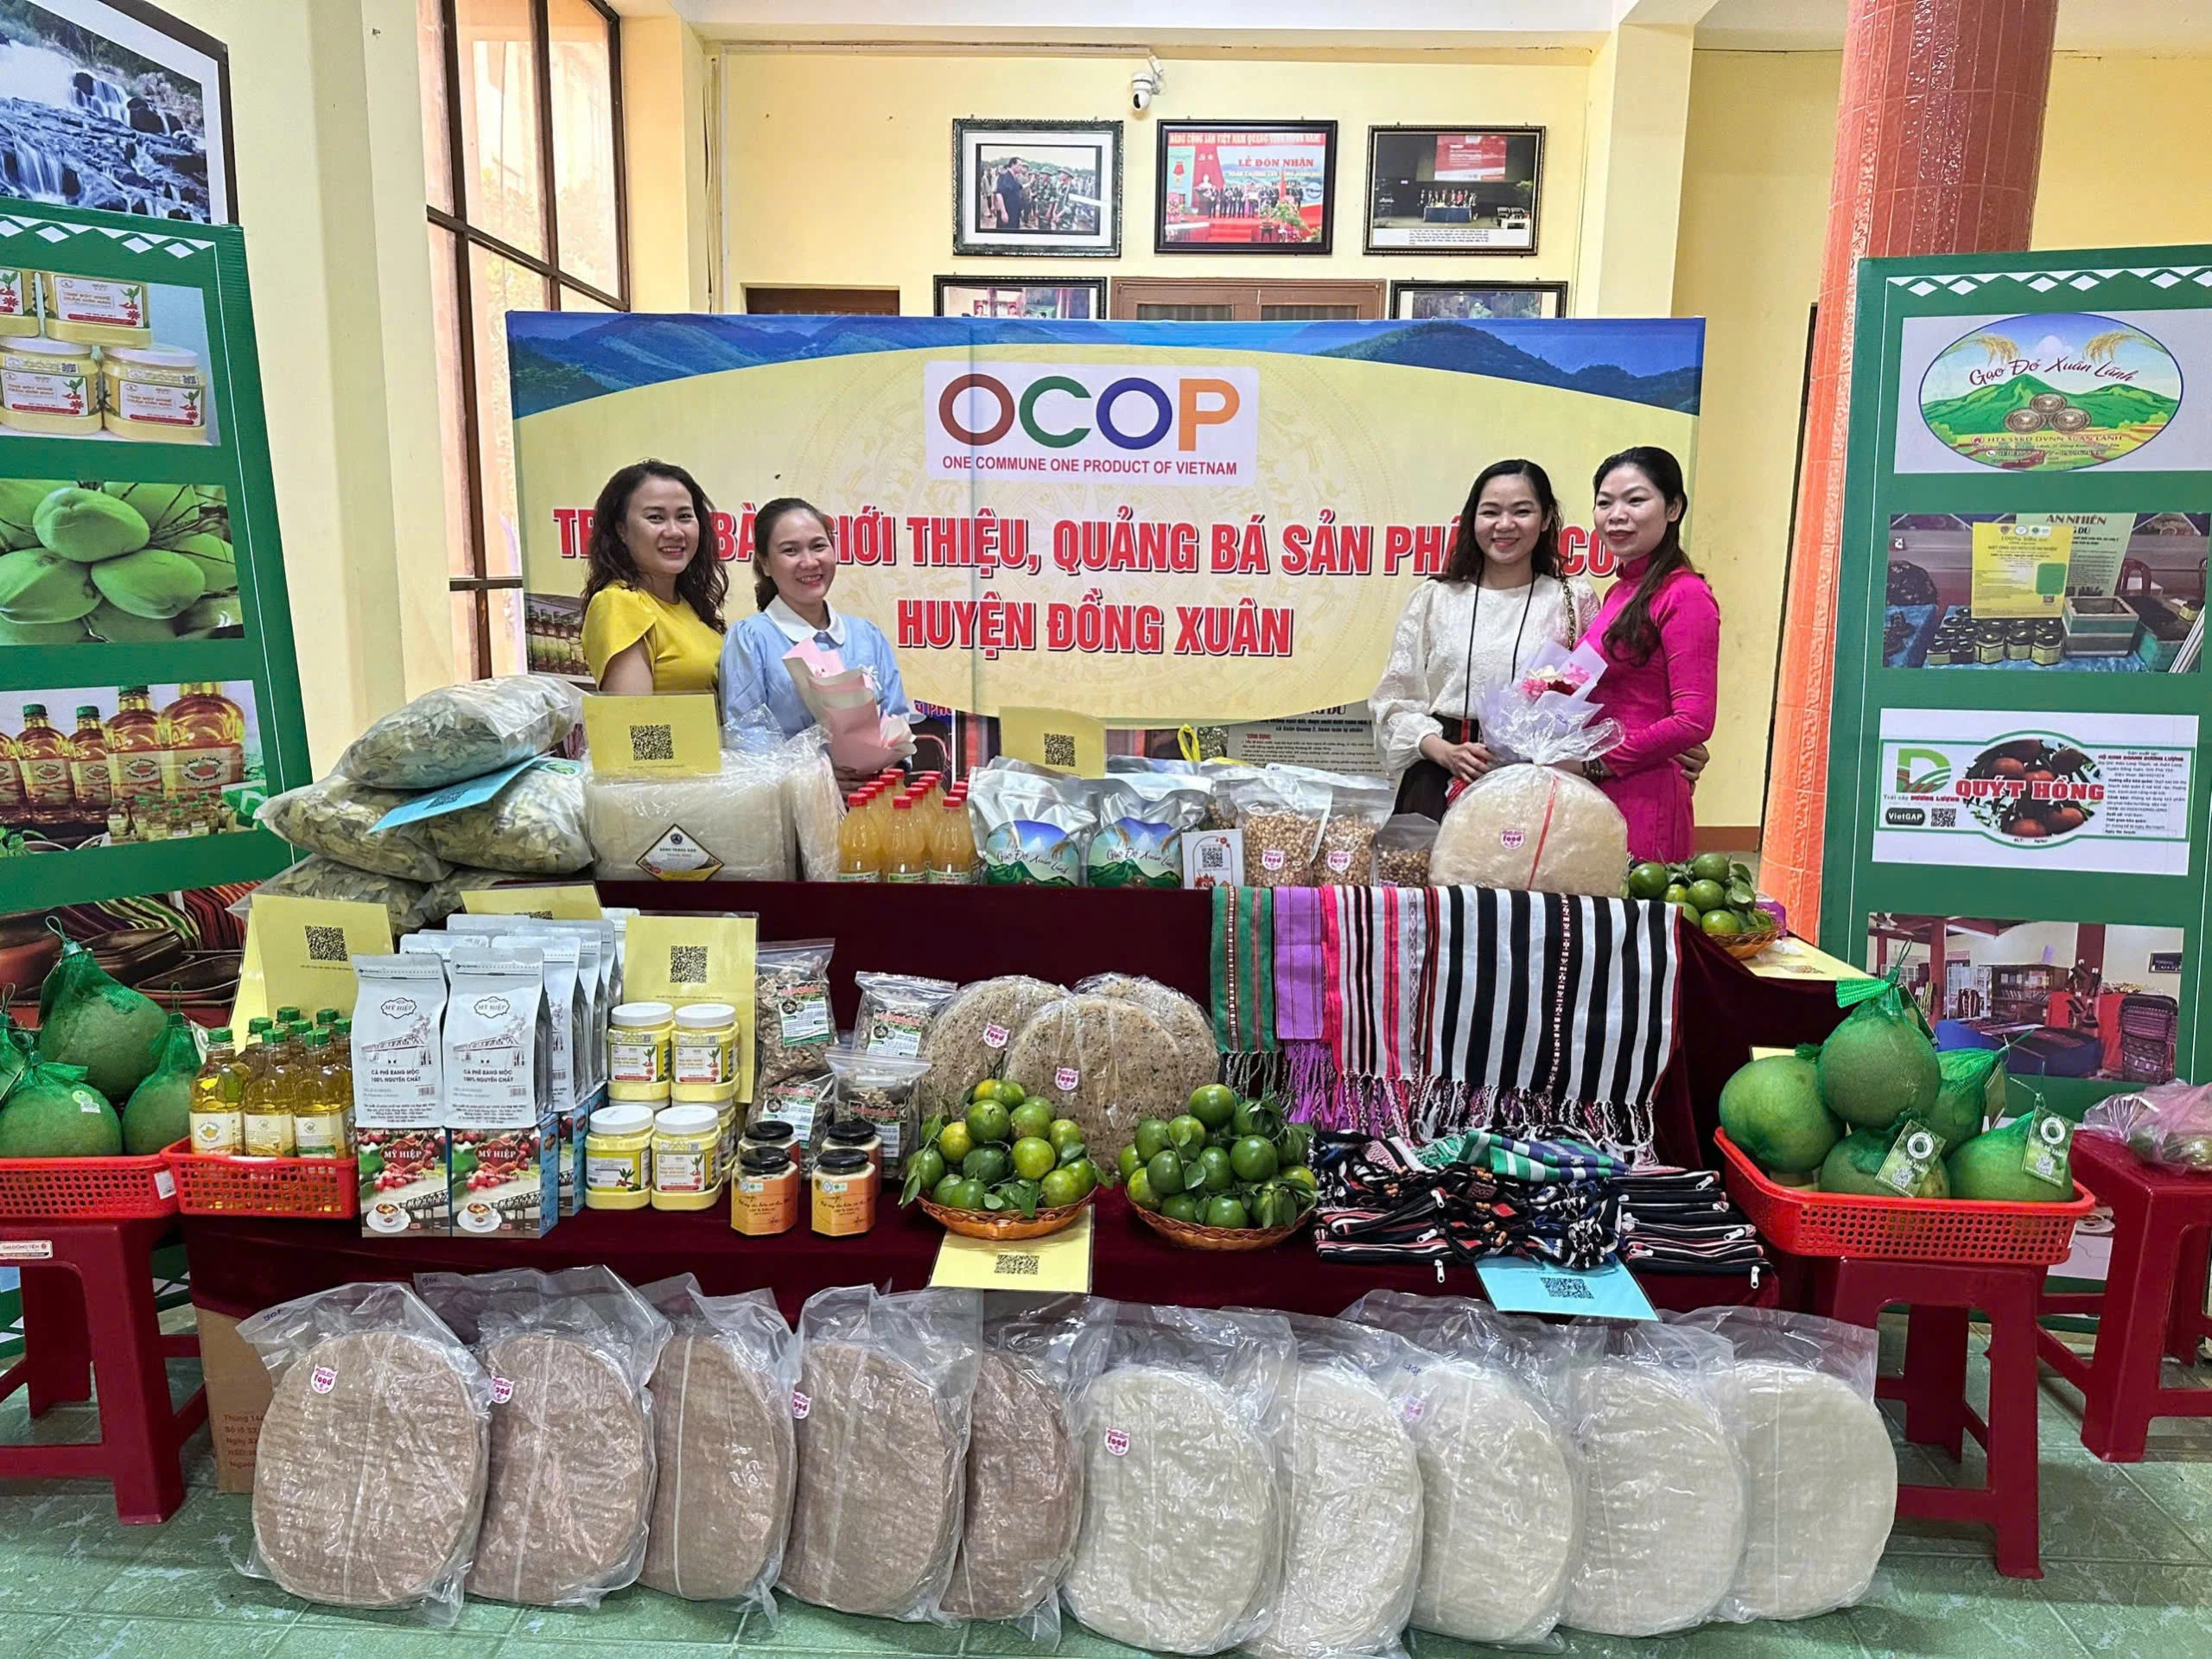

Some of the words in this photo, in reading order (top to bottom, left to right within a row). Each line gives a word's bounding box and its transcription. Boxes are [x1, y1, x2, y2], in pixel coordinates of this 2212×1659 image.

[1968, 366, 2005, 387] Gạo
[2012, 357, 2040, 374] Đỏ
[2044, 355, 2093, 373] Xuân
[2094, 361, 2141, 383] Lãnh
[938, 373, 1241, 452] OCOP
[943, 455, 971, 470] ONE
[976, 456, 1046, 472] COMMUNE
[1050, 458, 1080, 473] ONE
[1083, 459, 1150, 474] PRODUCT
[1154, 461, 1173, 474] OF
[1176, 461, 1238, 476] VIETNAM
[2046, 514, 2066, 524] AN
[2068, 514, 2107, 525] NHIÊN
[709, 501, 757, 564] BÀ
[906, 506, 1040, 576] THIỆU,
[1052, 505, 1199, 575] QUẢNG
[1210, 513, 1270, 575] BÁ
[1281, 508, 1374, 575] SẢN
[895, 595, 1035, 659] HUYỆN
[1046, 588, 1165, 653] ĐỒNG
[1173, 596, 1294, 657] XUÂN
[1955, 775, 2026, 799] QUÝT
[2031, 774, 2105, 801] HỒNG
[1888, 812, 1923, 821] VietGAP
[986, 1030, 1005, 1042] food
[499, 1068, 513, 1077] MỘC
[1057, 1075, 1076, 1084] food
[384, 1150, 398, 1159] MỸ
[399, 1149, 423, 1160] HIỆP
[478, 1149, 493, 1158] MỸ
[493, 1149, 517, 1159] HIỆP
[314, 1374, 334, 1386] food
[495, 1387, 511, 1396] ood
[794, 1401, 808, 1412] ood
[1107, 1435, 1128, 1448] food
